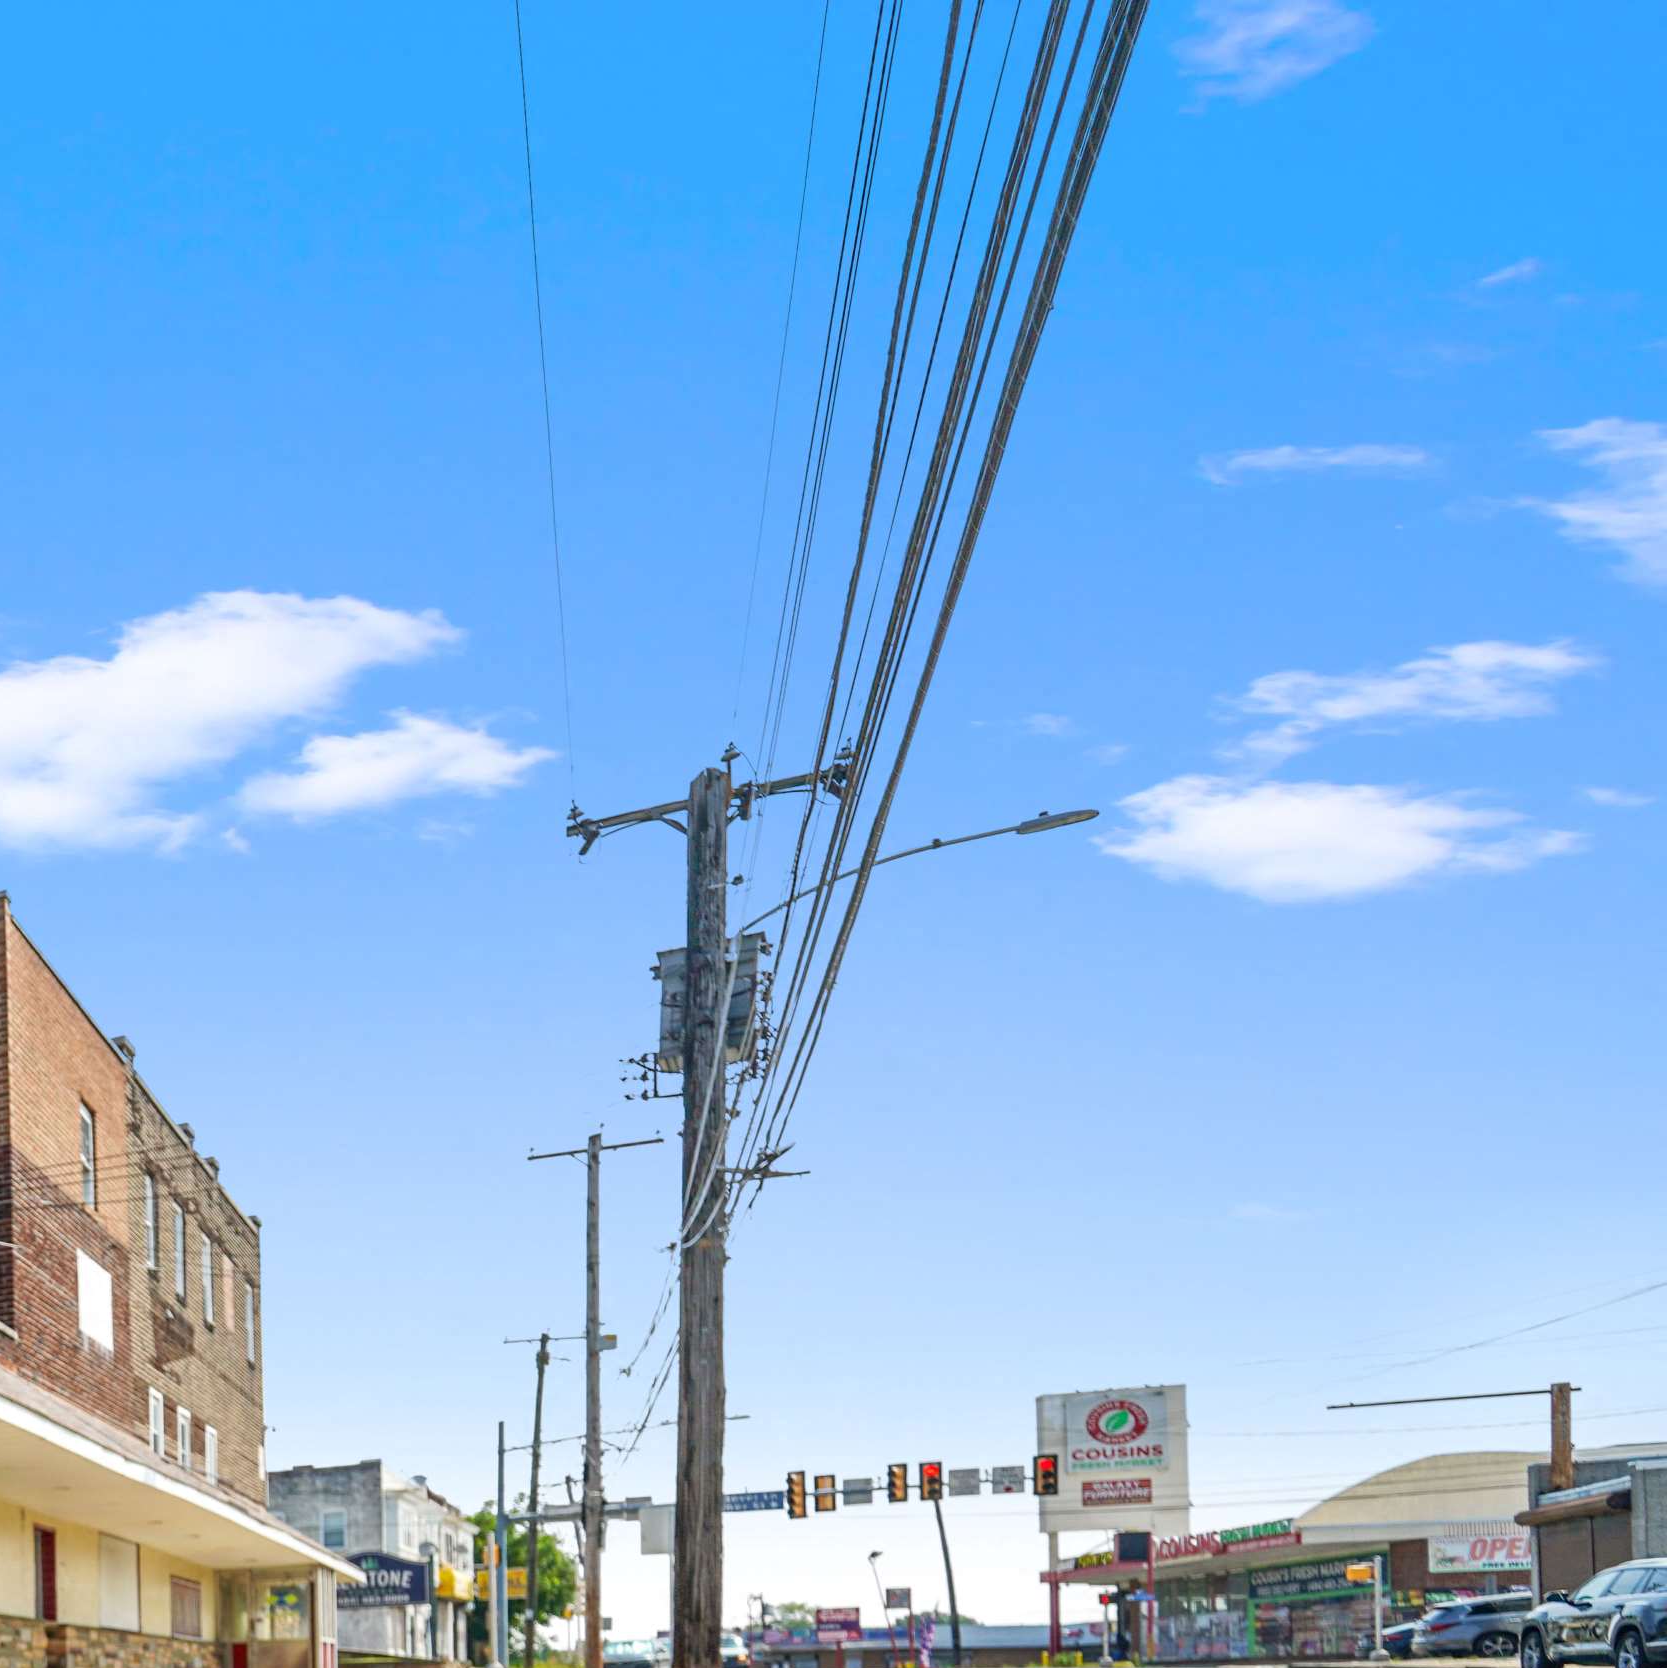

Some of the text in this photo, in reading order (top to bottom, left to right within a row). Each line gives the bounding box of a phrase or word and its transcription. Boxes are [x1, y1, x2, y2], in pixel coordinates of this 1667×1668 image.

[1071, 1444, 1164, 1461] COUSINS
[1159, 1532, 1222, 1559] COUSINS
[1469, 1536, 1532, 1562] OPE
